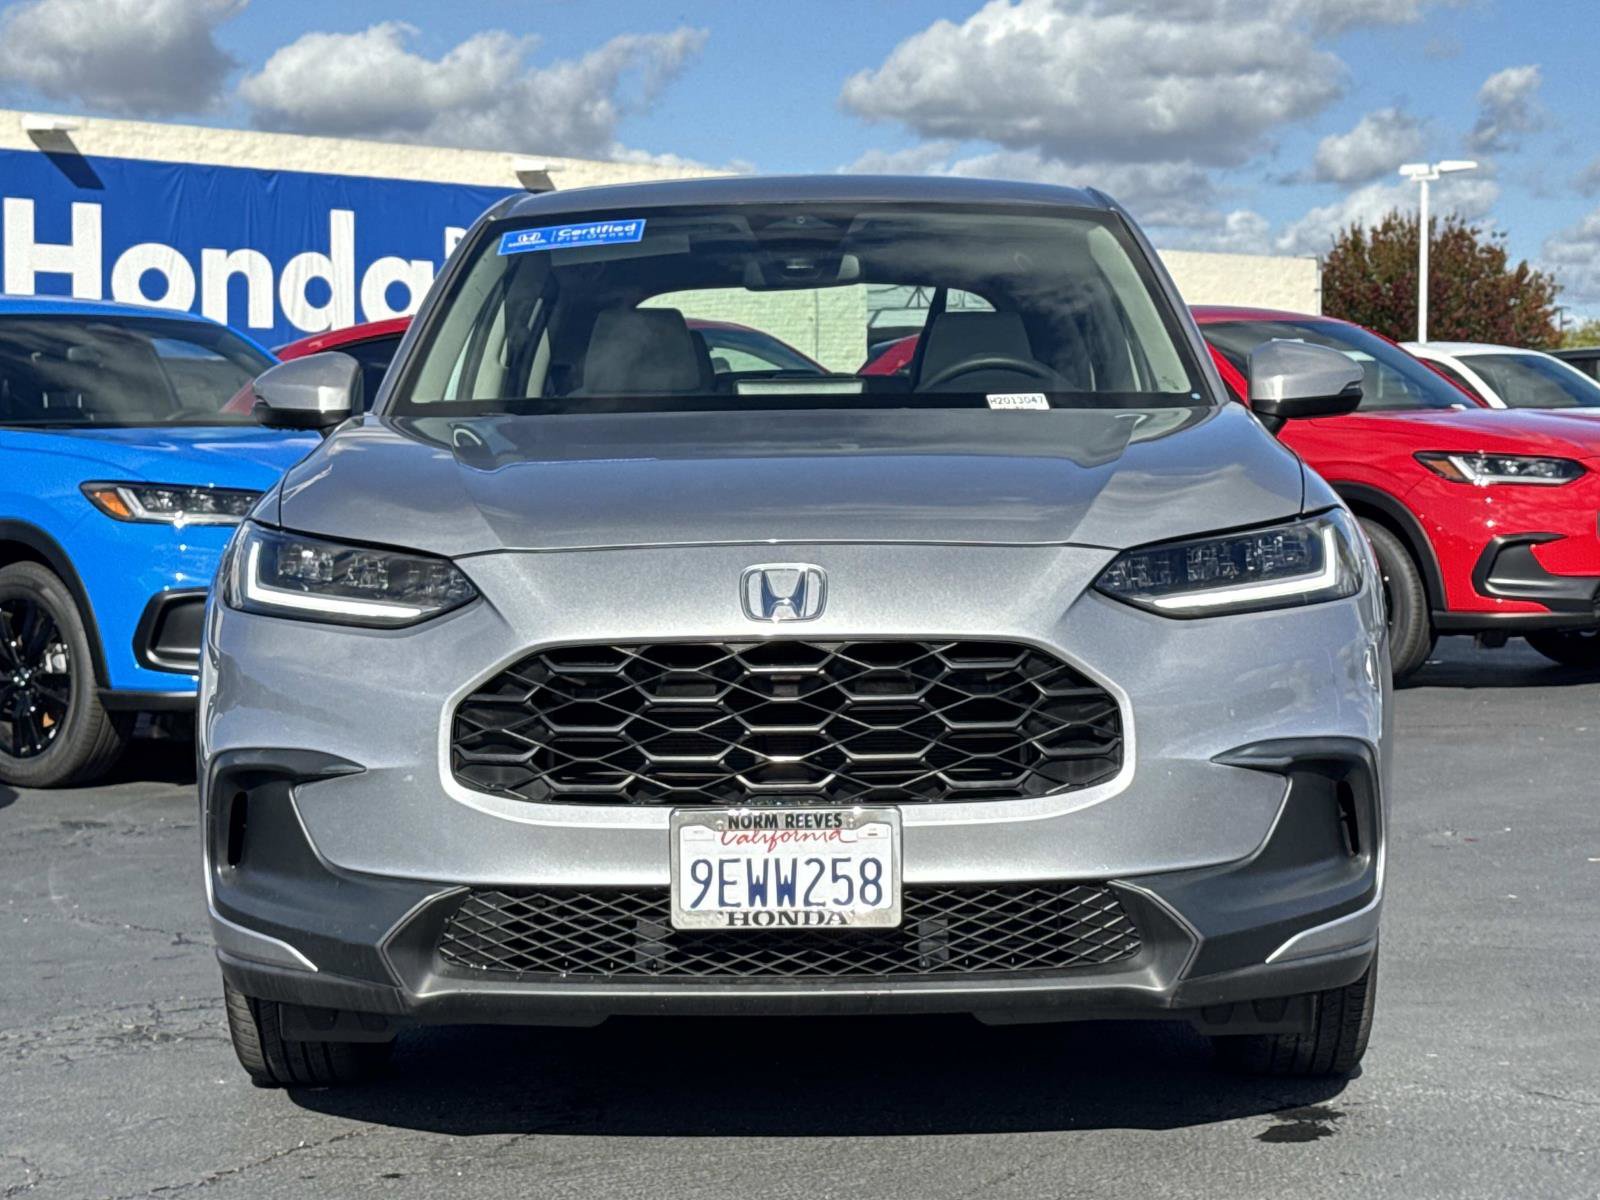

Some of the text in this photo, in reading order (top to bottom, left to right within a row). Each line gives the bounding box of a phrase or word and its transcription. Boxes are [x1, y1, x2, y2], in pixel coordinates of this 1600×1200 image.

[557, 223, 637, 237] Certified
[3, 197, 434, 333] Honda
[728, 813, 843, 829] NORM REEVES
[721, 829, 858, 853] California
[690, 857, 883, 909] 9EWW258
[726, 910, 850, 926] HONDA
